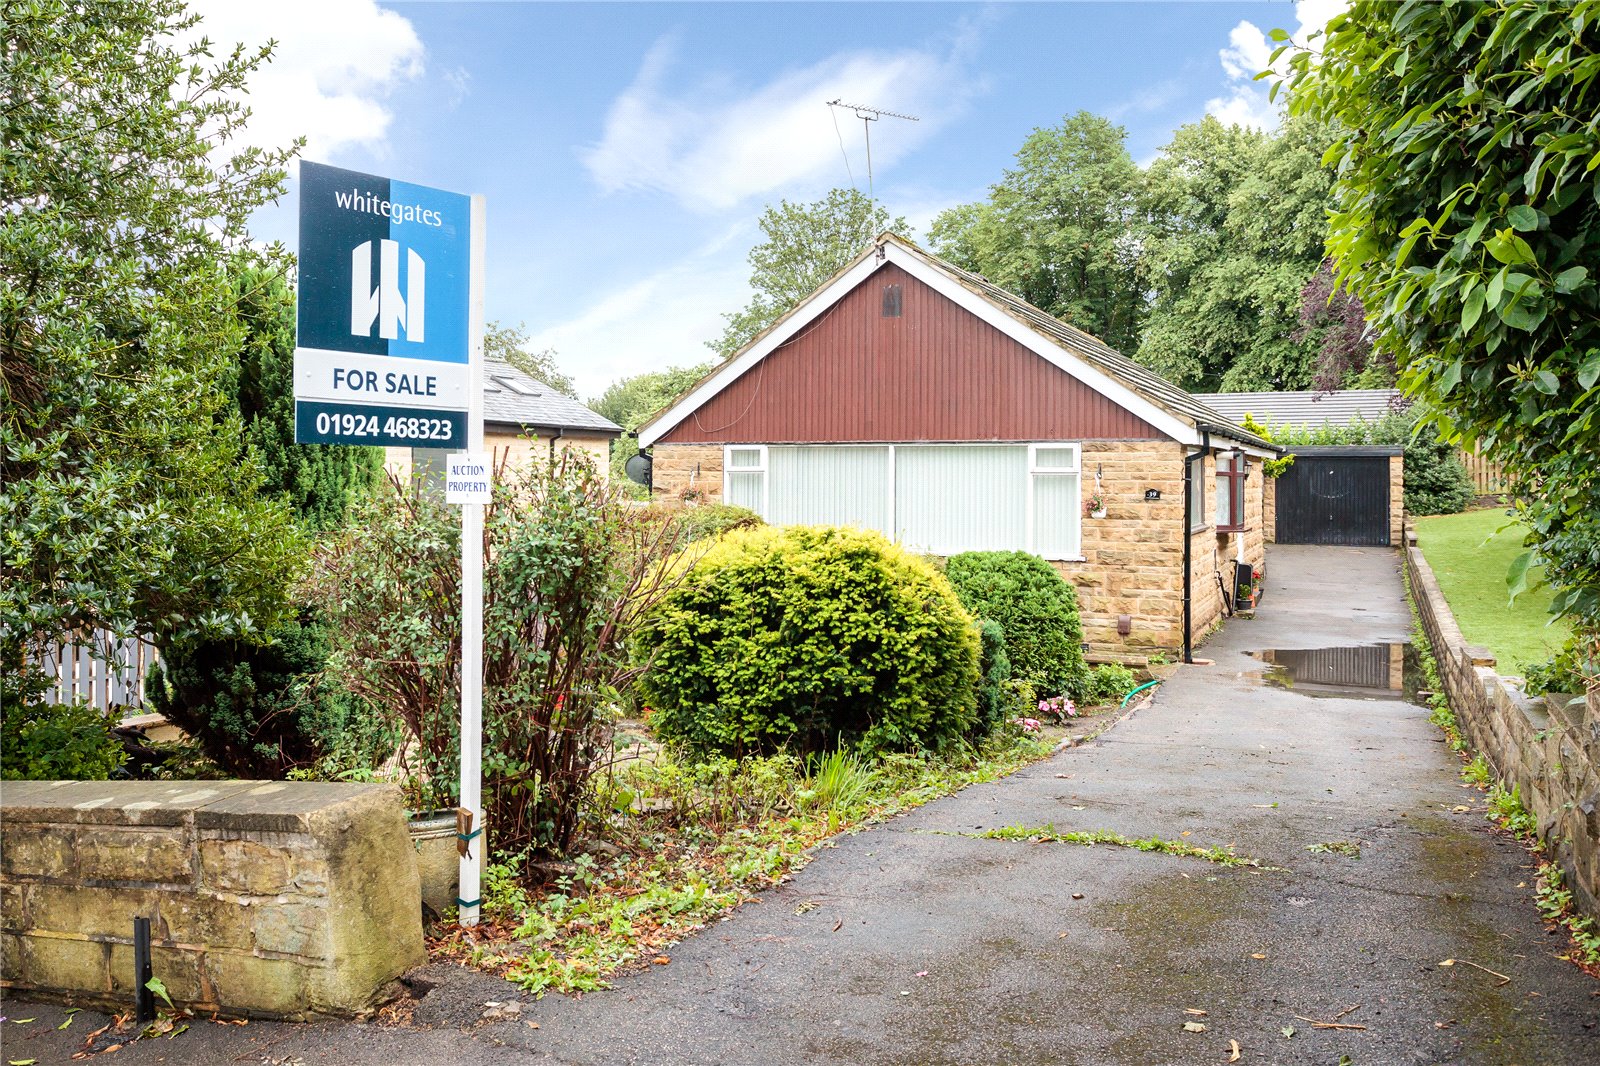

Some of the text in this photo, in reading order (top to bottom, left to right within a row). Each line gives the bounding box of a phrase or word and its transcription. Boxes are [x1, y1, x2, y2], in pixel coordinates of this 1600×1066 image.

[334, 188, 442, 227] whitegates
[333, 368, 437, 396] FOR SALE
[316, 412, 453, 440] 01924 468323
[451, 465, 485, 475] AUCTION
[448, 481, 488, 492] PROPERTY
